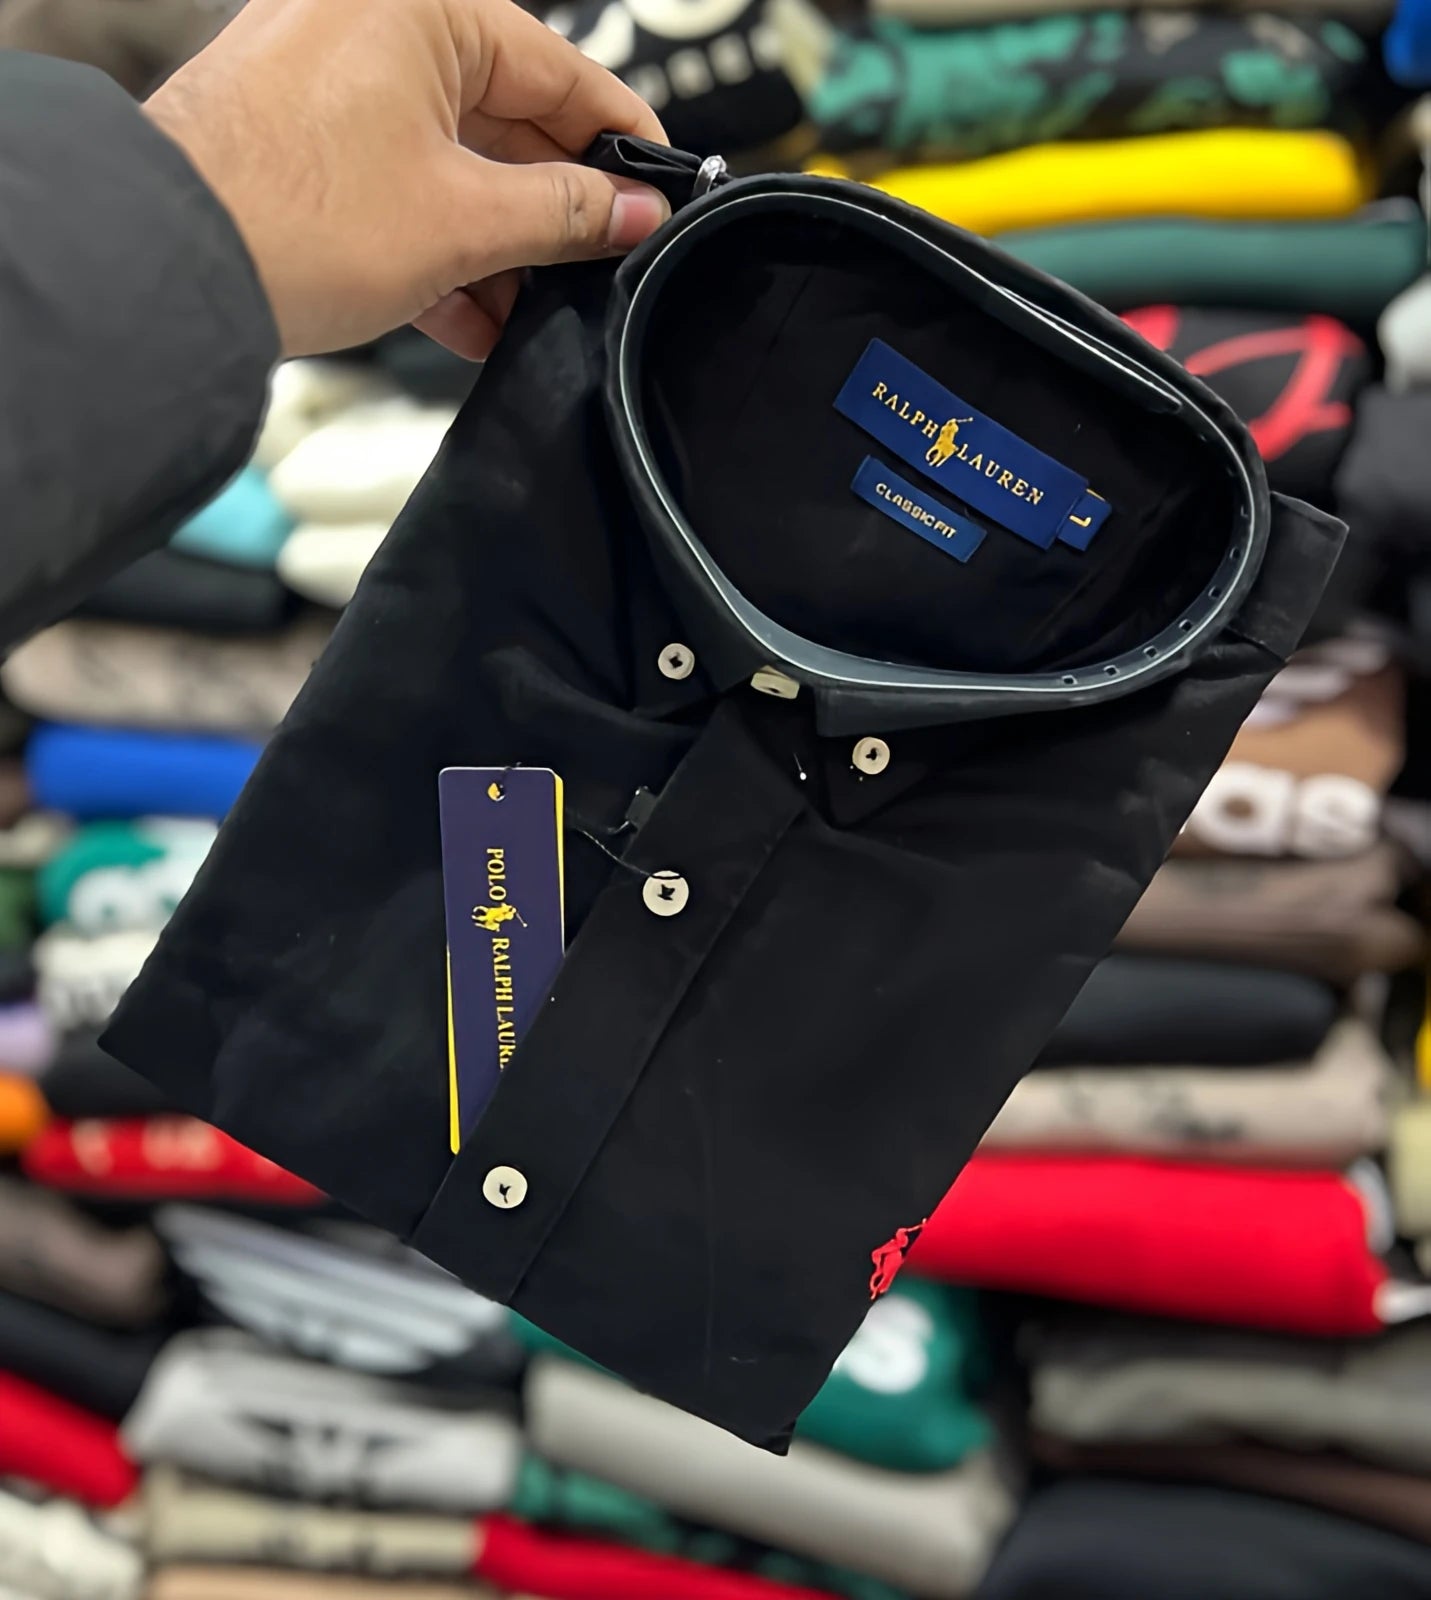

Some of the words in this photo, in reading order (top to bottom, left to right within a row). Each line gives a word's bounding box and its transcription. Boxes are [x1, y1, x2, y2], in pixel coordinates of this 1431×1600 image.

[872, 382, 939, 439] RALPH
[957, 443, 1045, 505] LAUREN
[875, 482, 936, 527] CLASSIC
[933, 520, 957, 539] FIT
[1069, 514, 1092, 528] L
[486, 848, 507, 901] POLO
[492, 938, 513, 1001] RALPH
